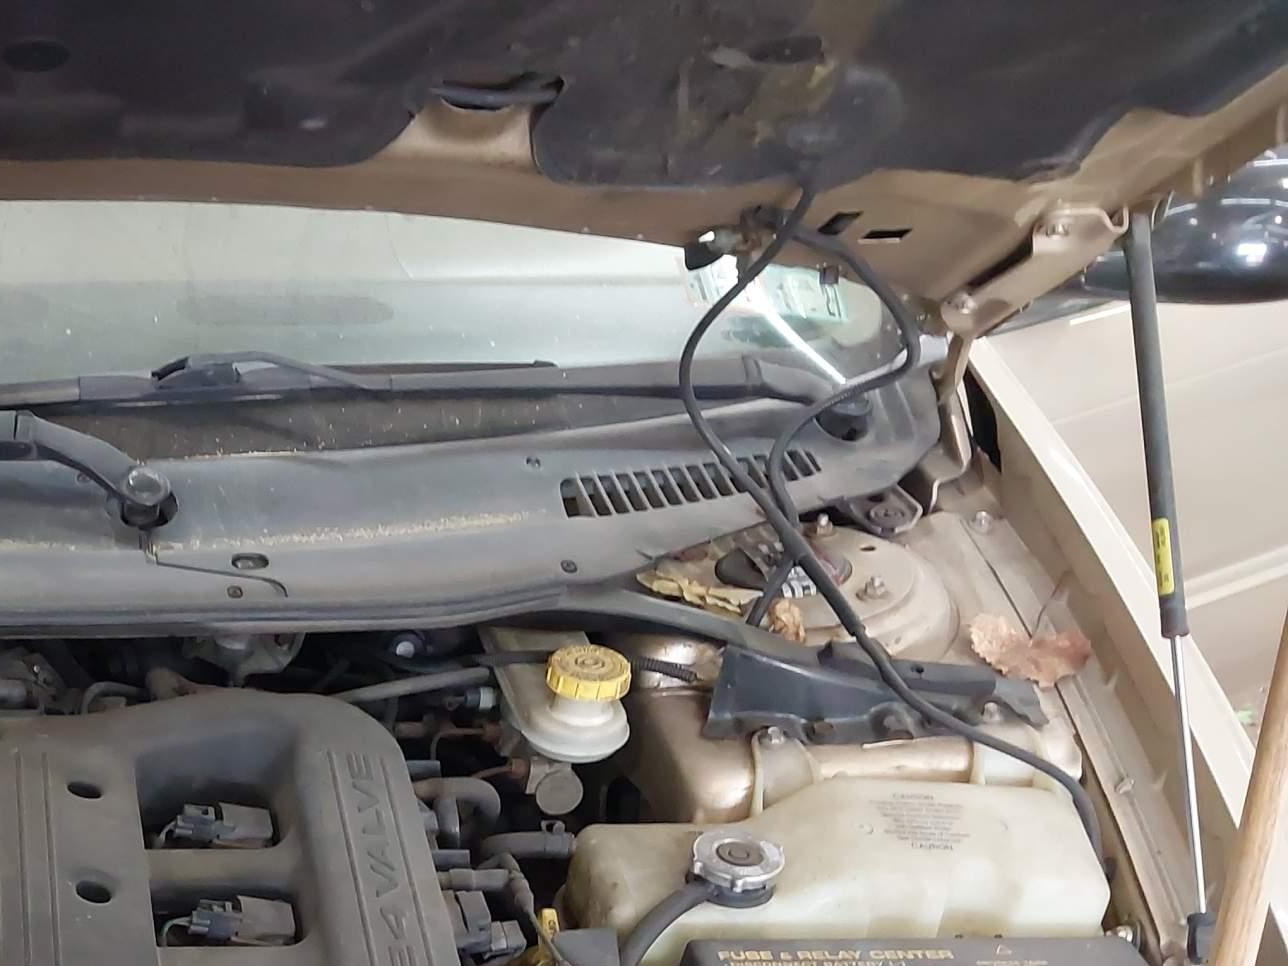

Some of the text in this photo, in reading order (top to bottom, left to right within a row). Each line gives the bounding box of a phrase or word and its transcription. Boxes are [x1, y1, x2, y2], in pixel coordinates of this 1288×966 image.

[347, 751, 399, 898] VALVE
[718, 950, 774, 960] FUSE
[797, 950, 861, 960] RELAY
[870, 950, 954, 960] CENTER
